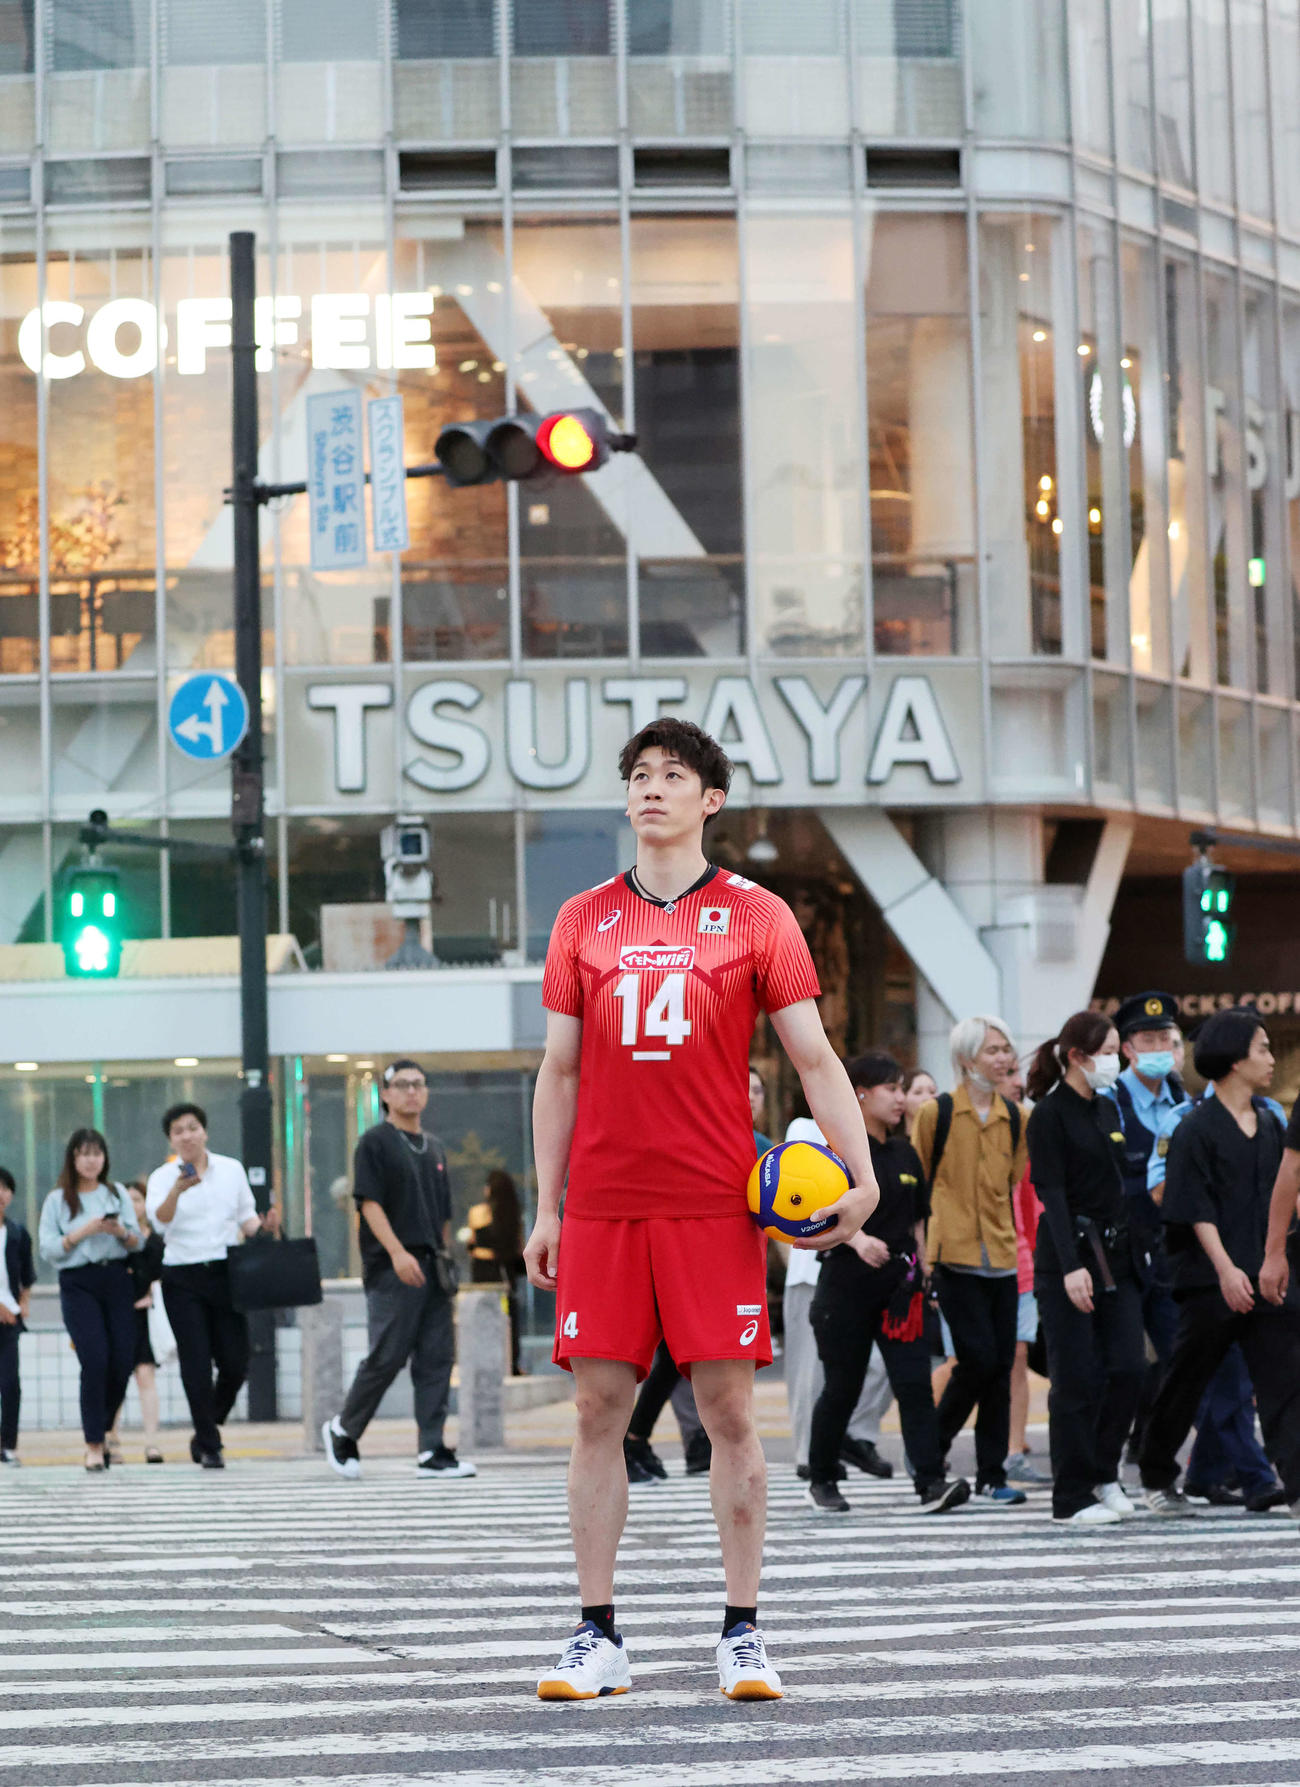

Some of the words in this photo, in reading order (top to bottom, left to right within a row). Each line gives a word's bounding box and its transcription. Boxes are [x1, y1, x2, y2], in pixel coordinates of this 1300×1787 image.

[18, 292, 437, 380] COFFEE
[330, 404, 360, 554] 渋谷駅前
[307, 675, 960, 794] TSUTAYA
[702, 923, 727, 933] JPN
[613, 973, 692, 1046] 14
[801, 1219, 828, 1233] V200W
